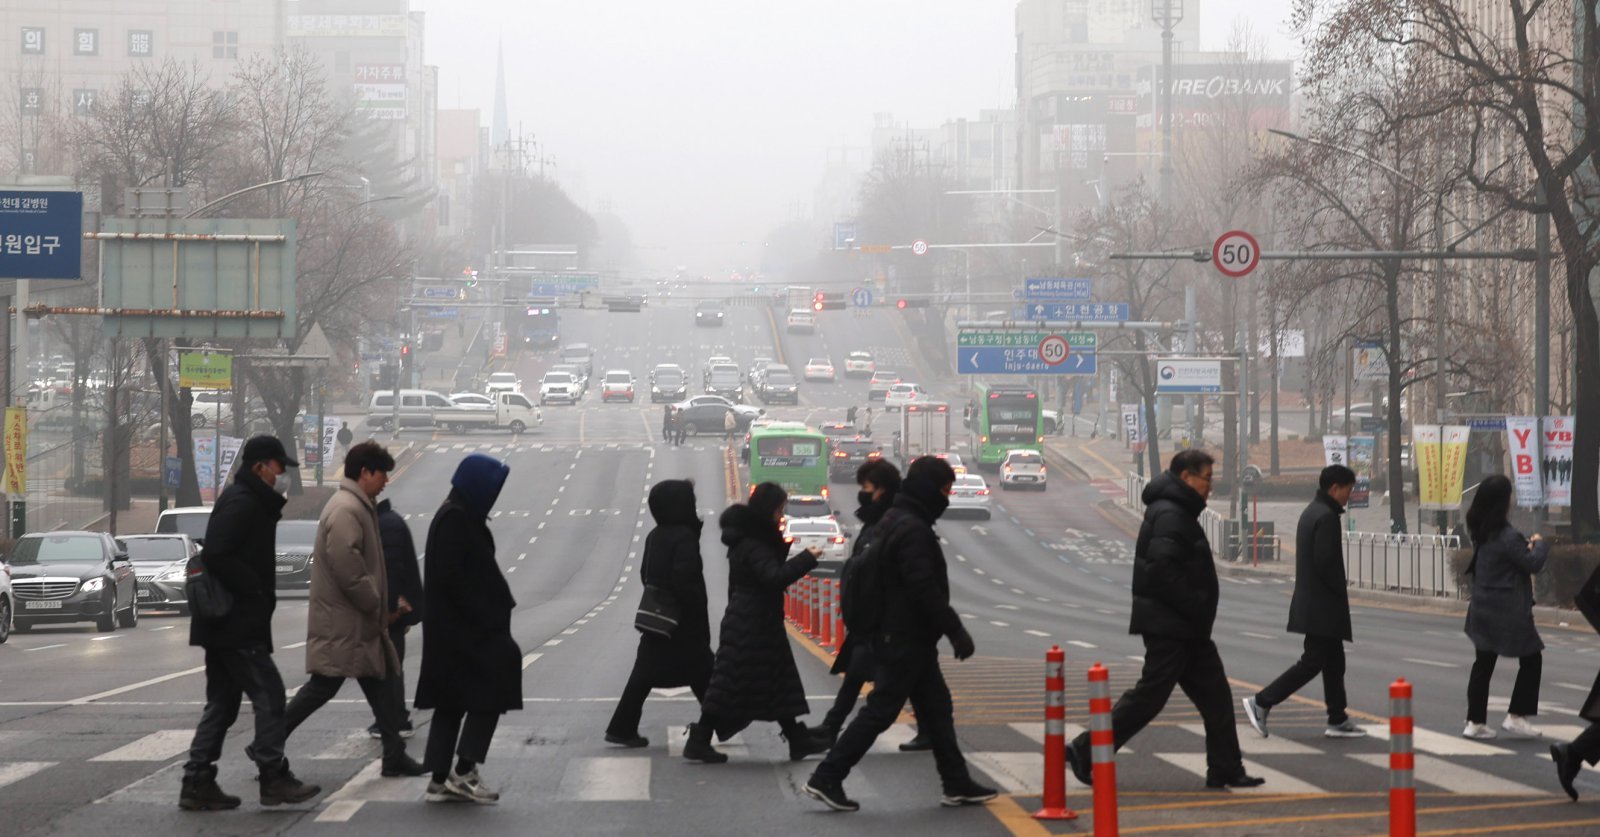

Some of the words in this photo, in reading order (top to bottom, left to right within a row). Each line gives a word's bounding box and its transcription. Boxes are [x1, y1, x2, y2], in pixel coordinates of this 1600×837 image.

[25, 31, 41, 51] 의
[78, 32, 94, 51] 힘
[356, 66, 402, 80] 가자주류
[0, 197, 20, 209] 천대
[21, 197, 48, 209] 길병원
[1223, 244, 1250, 264] 50
[1065, 304, 1118, 314] 인천공항
[1004, 349, 1038, 361] 인주대
[1045, 343, 1063, 358] 50
[1544, 431, 1572, 442] YB
